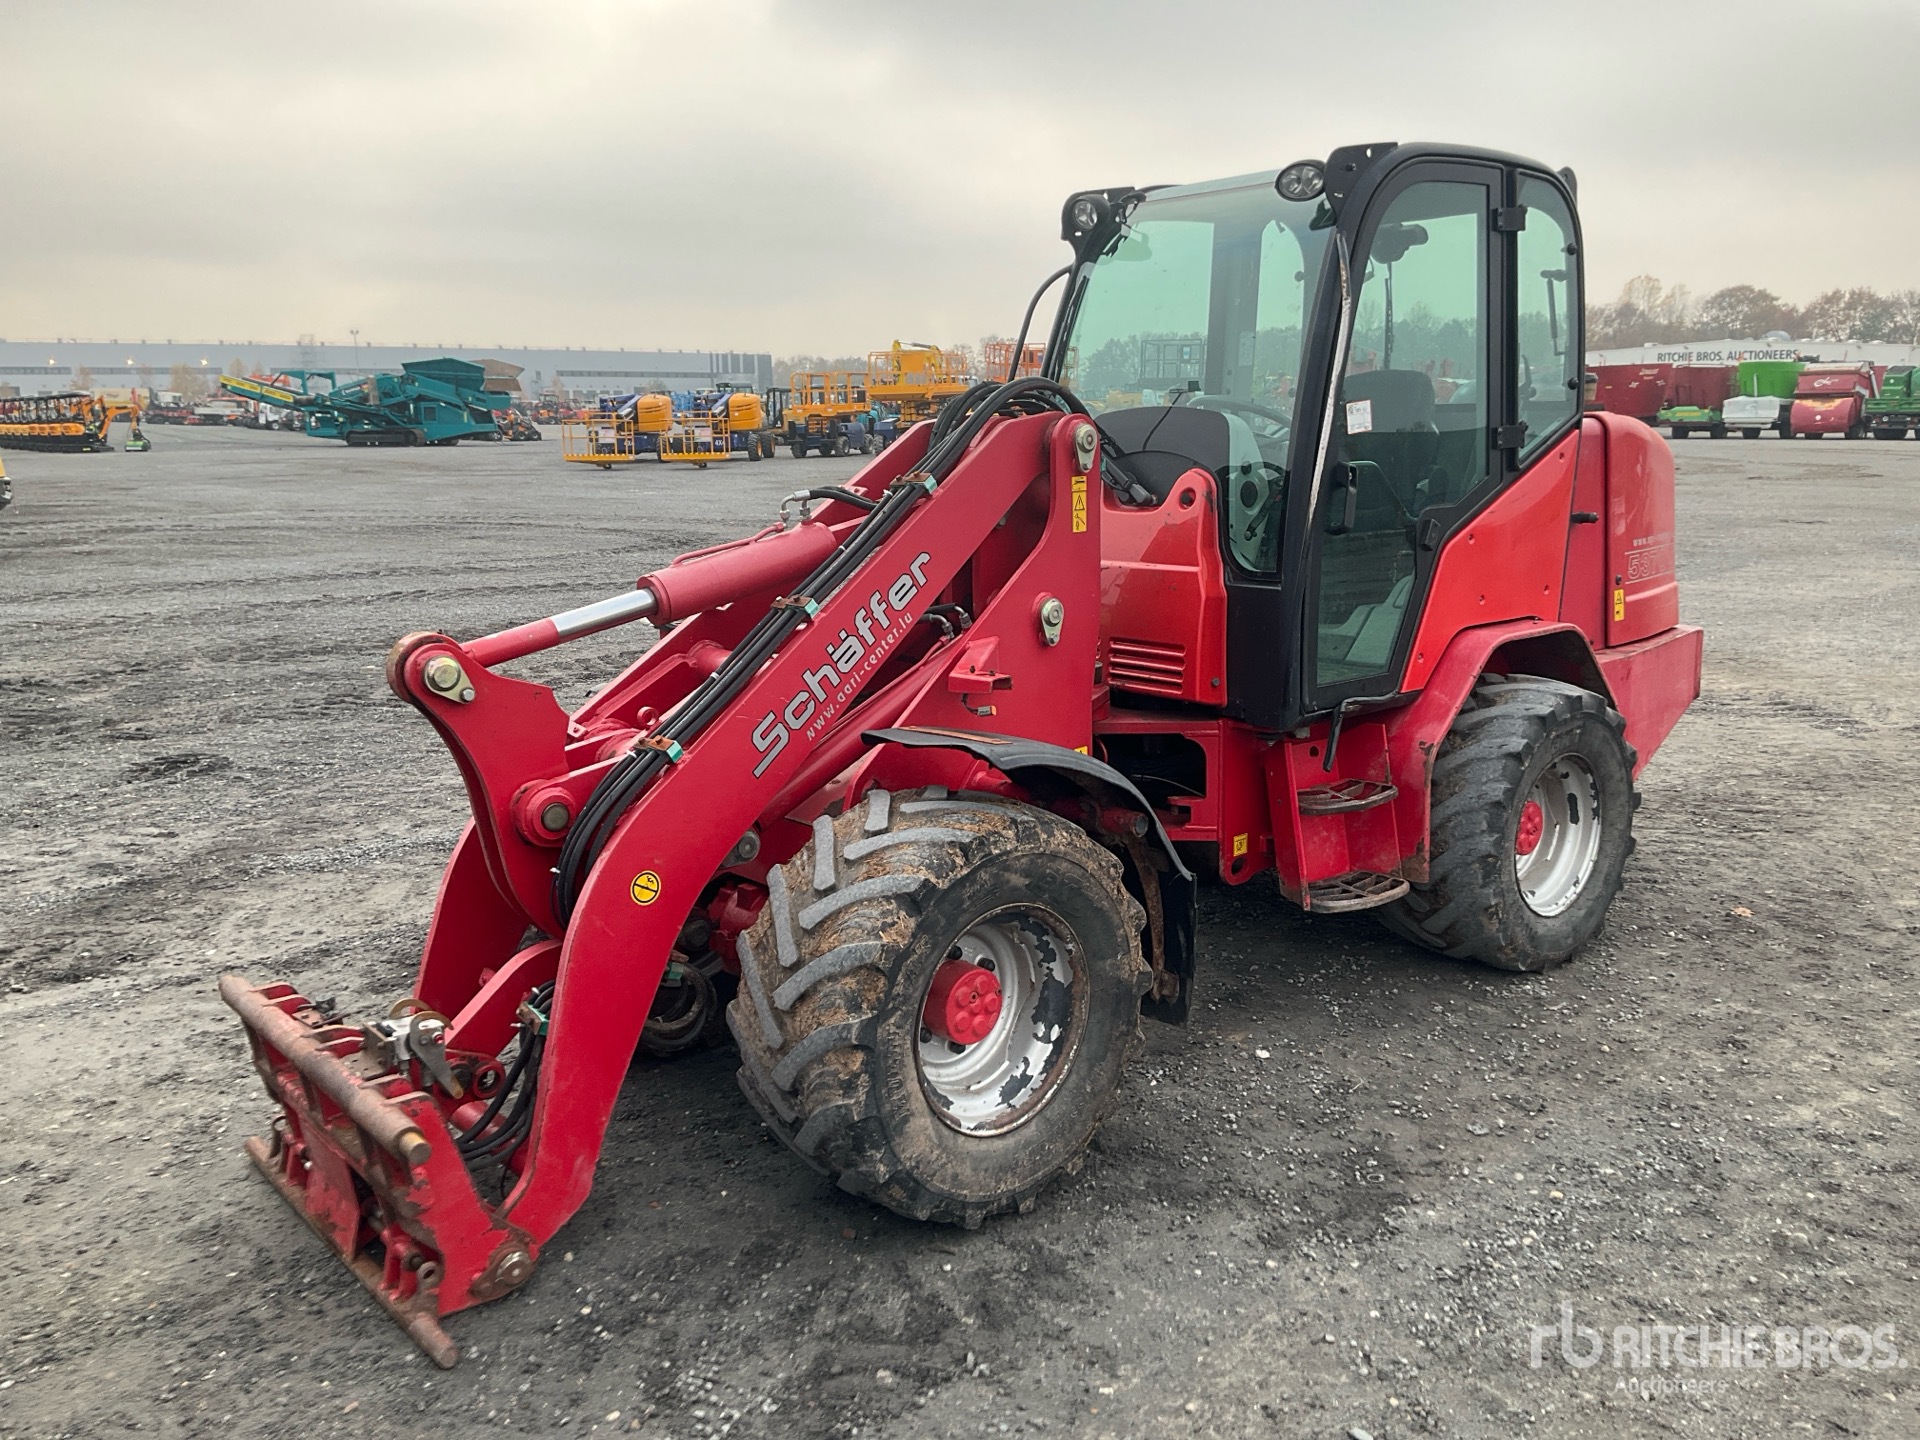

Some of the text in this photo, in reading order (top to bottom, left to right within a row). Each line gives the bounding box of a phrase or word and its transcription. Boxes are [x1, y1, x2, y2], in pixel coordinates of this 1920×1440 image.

[1657, 350, 1799, 362] RITCHIE BROS. AUCTIONEERS
[752, 552, 931, 779] Schäffer
